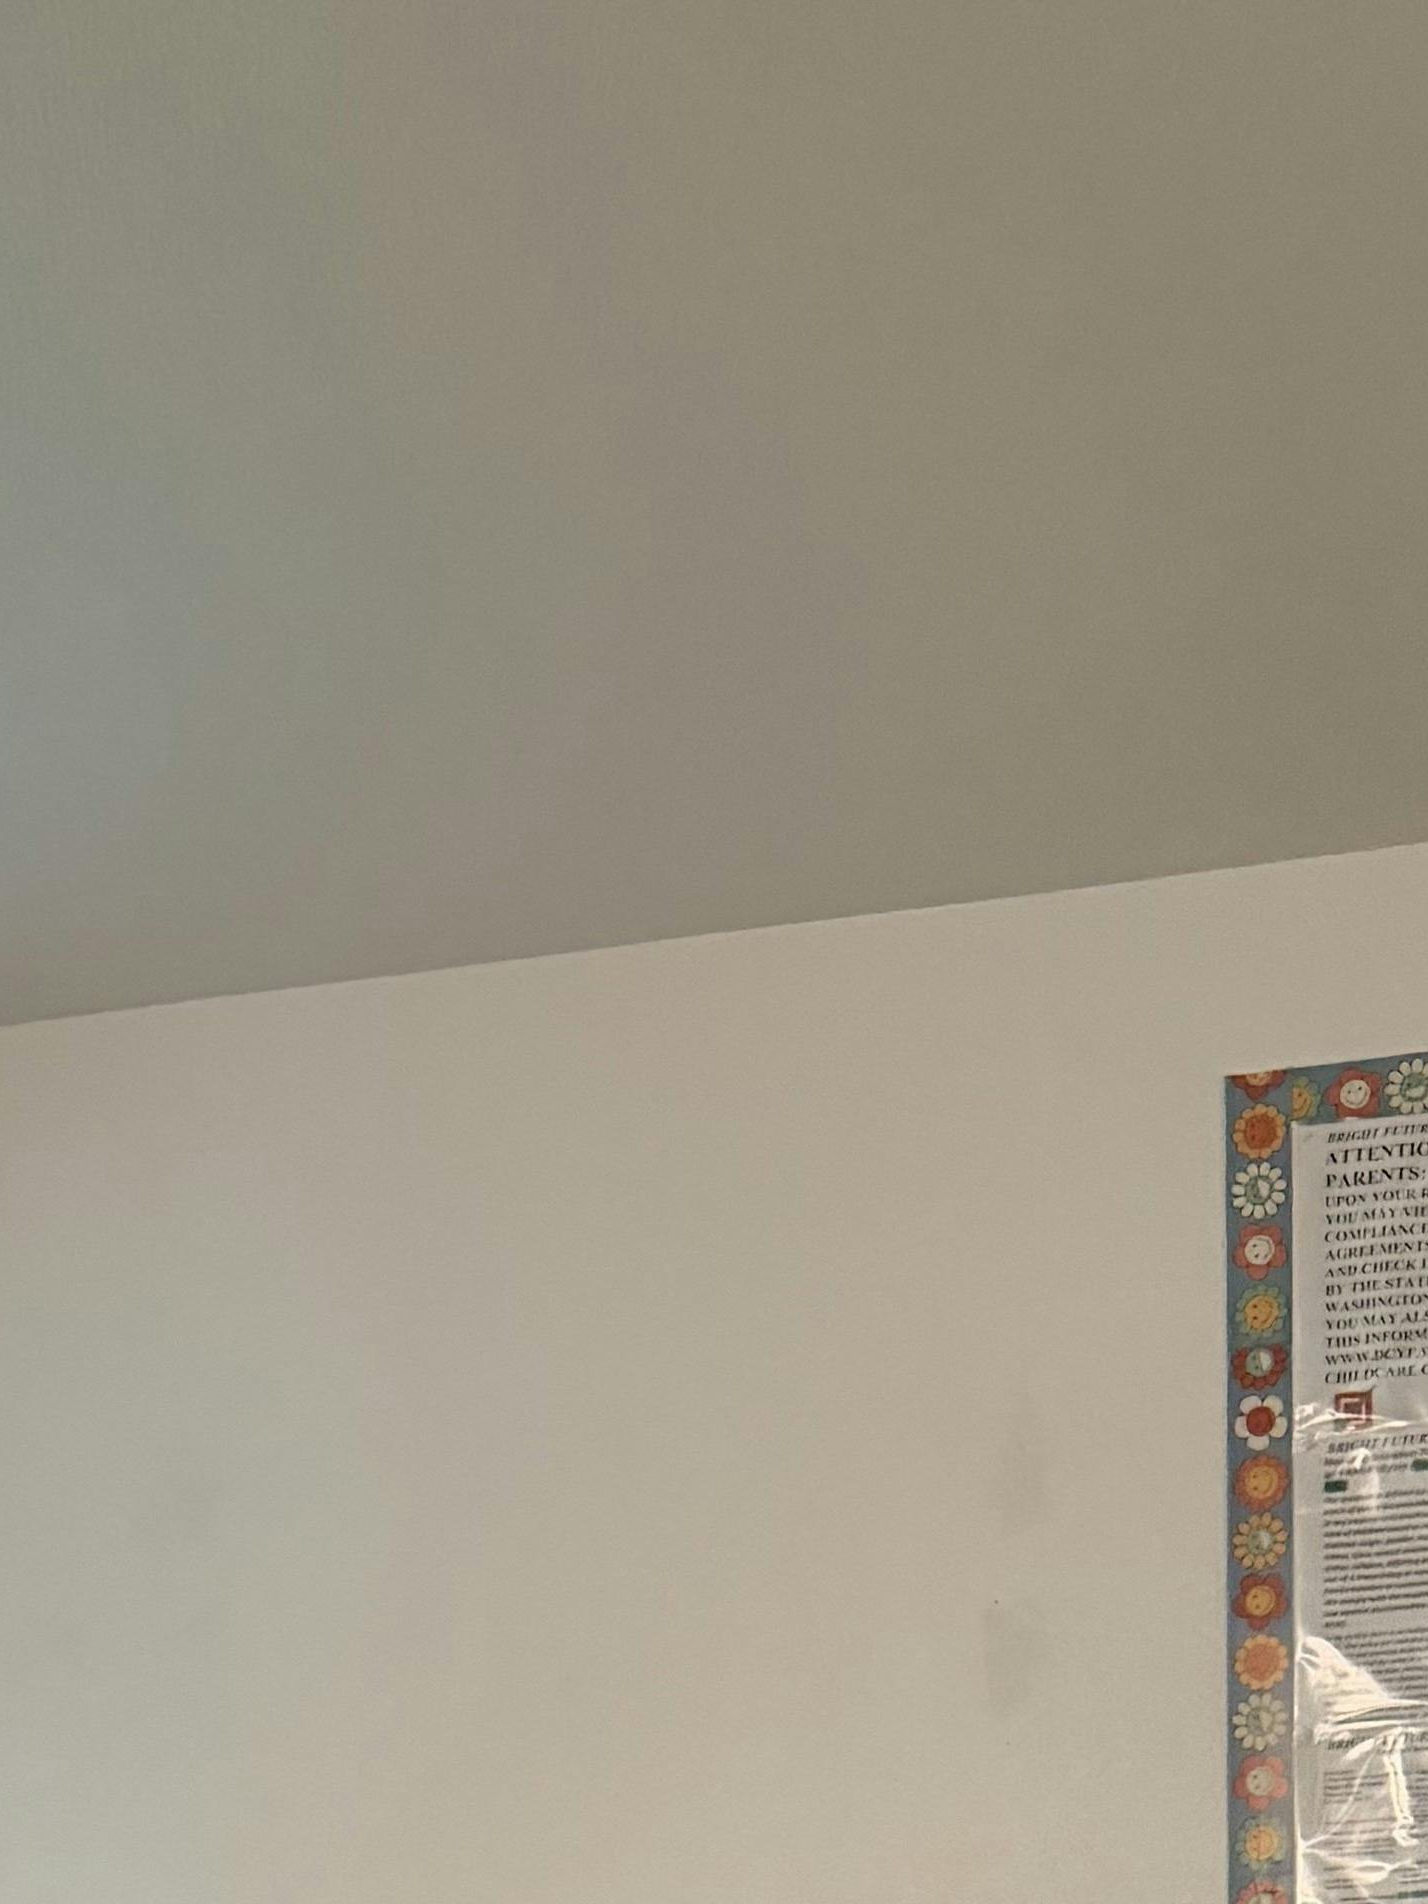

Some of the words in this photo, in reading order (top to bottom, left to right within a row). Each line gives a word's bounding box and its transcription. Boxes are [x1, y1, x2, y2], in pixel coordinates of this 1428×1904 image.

[1326, 1167, 1427, 1189] PARENTS:
[1326, 1193, 1366, 1208] UPON
[1373, 1188, 1416, 1202] YOUR
[1325, 1262, 1357, 1278] AND
[1361, 1255, 1416, 1274] CHECK
